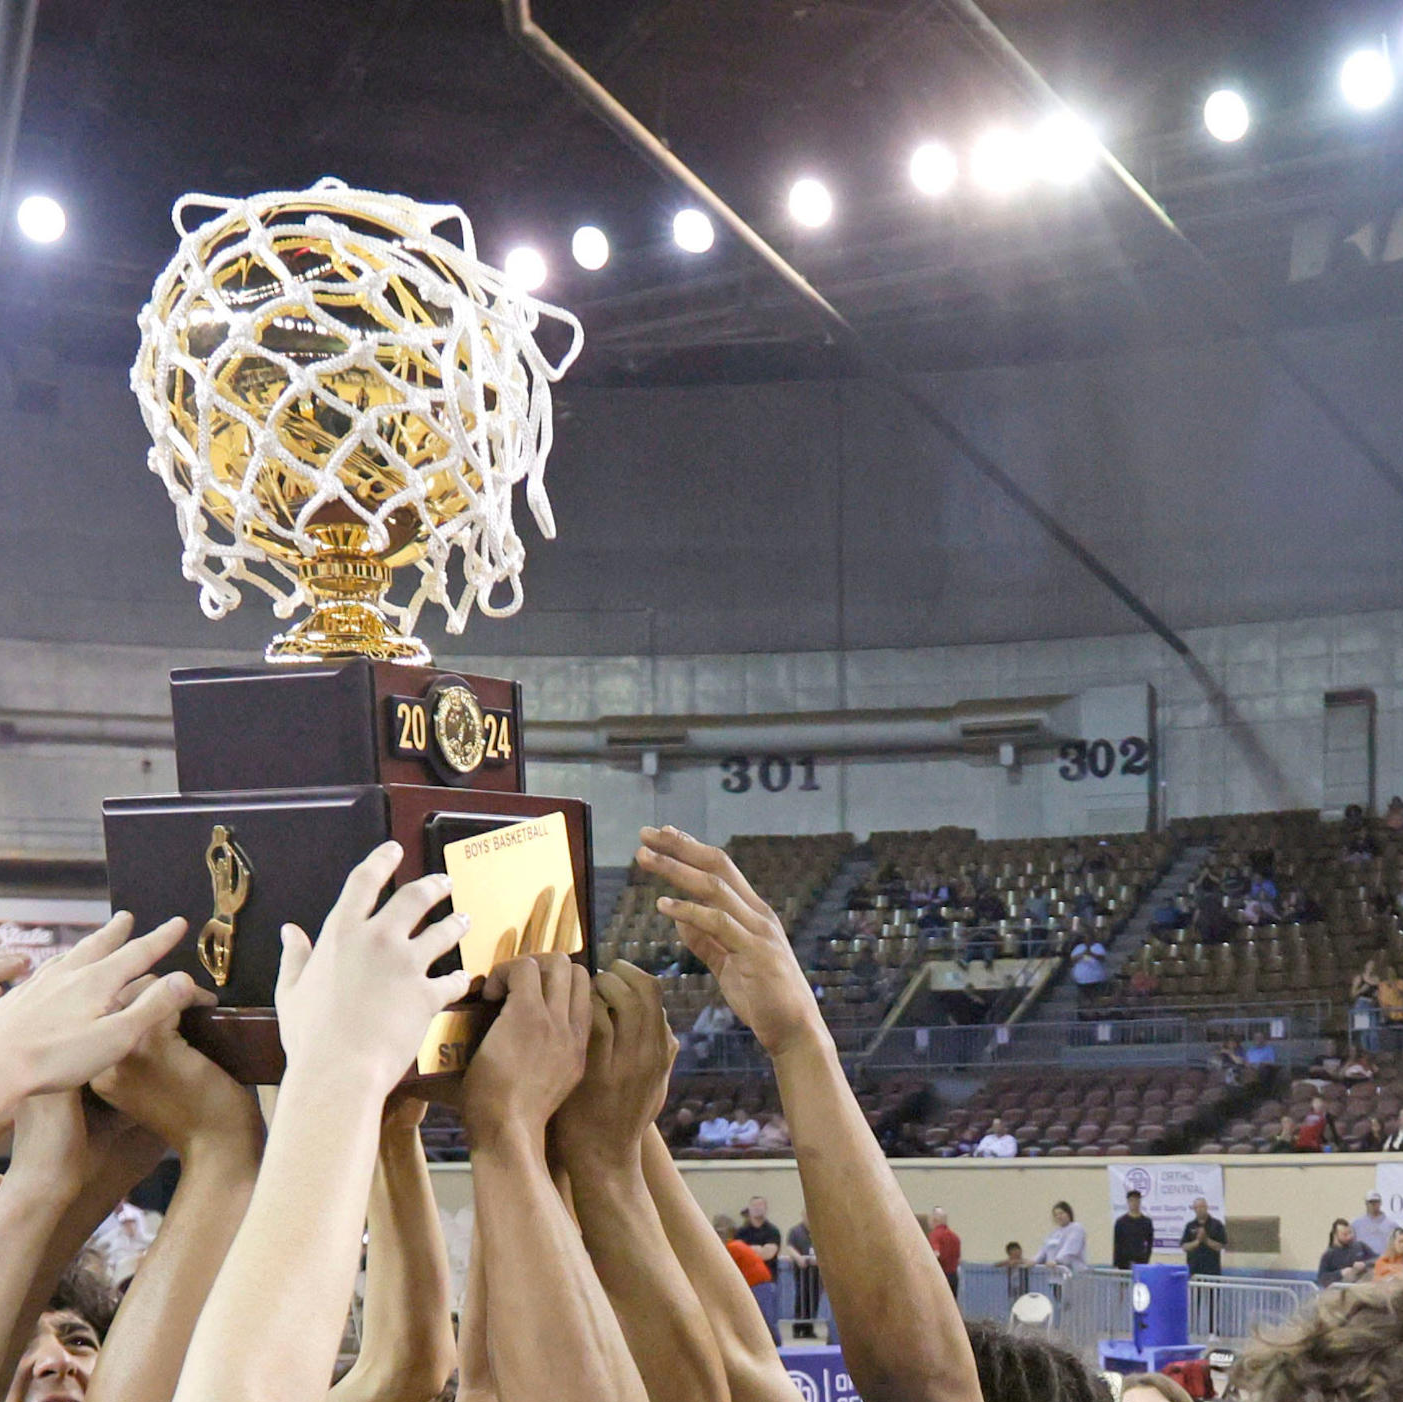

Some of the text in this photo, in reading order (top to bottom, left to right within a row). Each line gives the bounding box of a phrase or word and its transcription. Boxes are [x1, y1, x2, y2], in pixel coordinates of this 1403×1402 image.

[397, 703, 427, 751] 20
[484, 713, 512, 759] 24
[720, 754, 821, 794] 301
[1058, 736, 1150, 782] 302
[492, 823, 549, 851] BASKETBALL
[439, 1042, 465, 1067] ST
